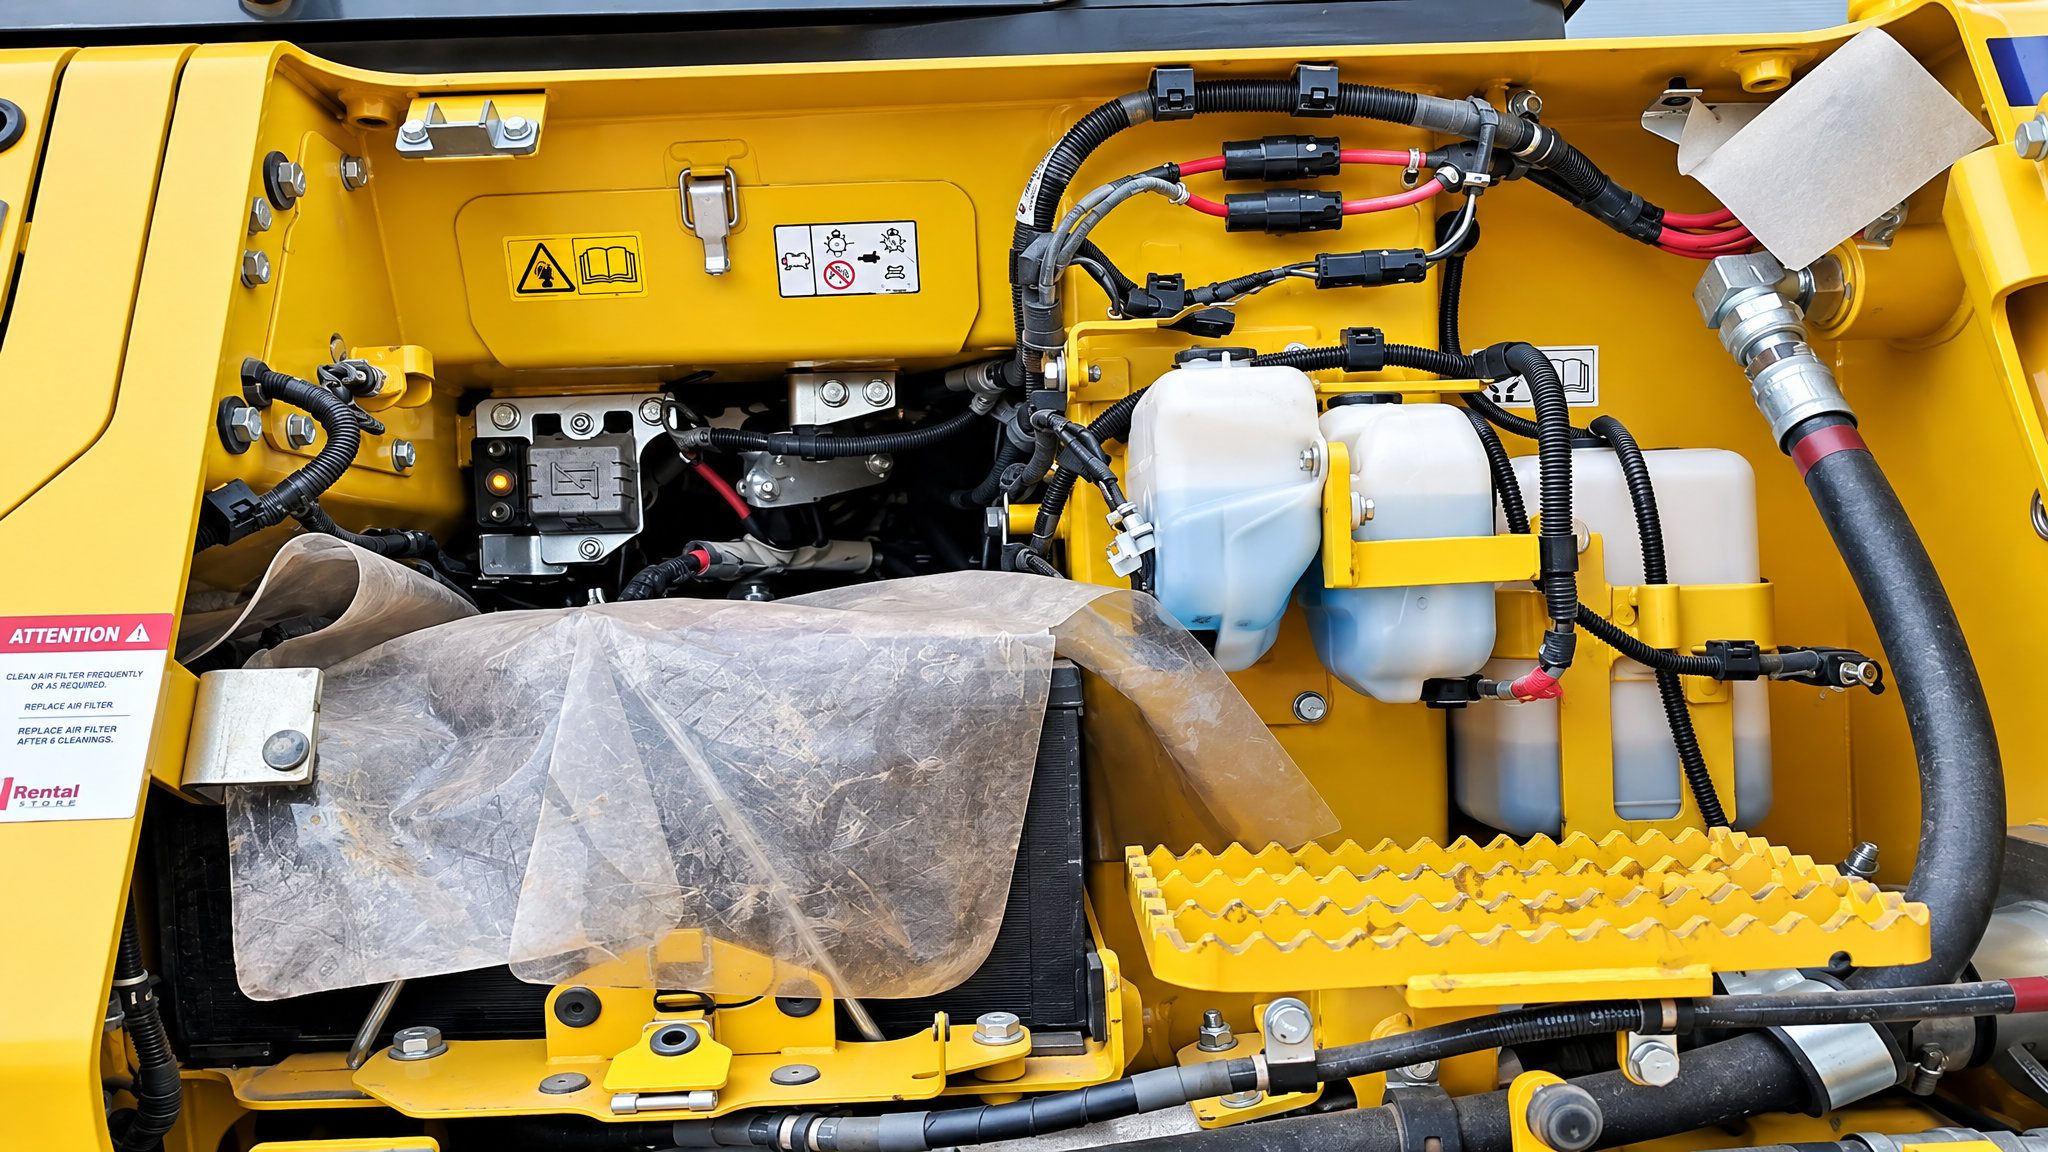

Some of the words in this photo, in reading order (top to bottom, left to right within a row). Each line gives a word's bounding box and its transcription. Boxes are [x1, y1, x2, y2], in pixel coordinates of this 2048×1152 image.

[9, 626, 120, 644] ATTENTION
[60, 681, 107, 689] REQUIRED.
[66, 726, 81, 734] AIR
[17, 737, 47, 745] AFTER
[58, 736, 113, 744] CLEANINGS.
[14, 785, 80, 799] Rental
